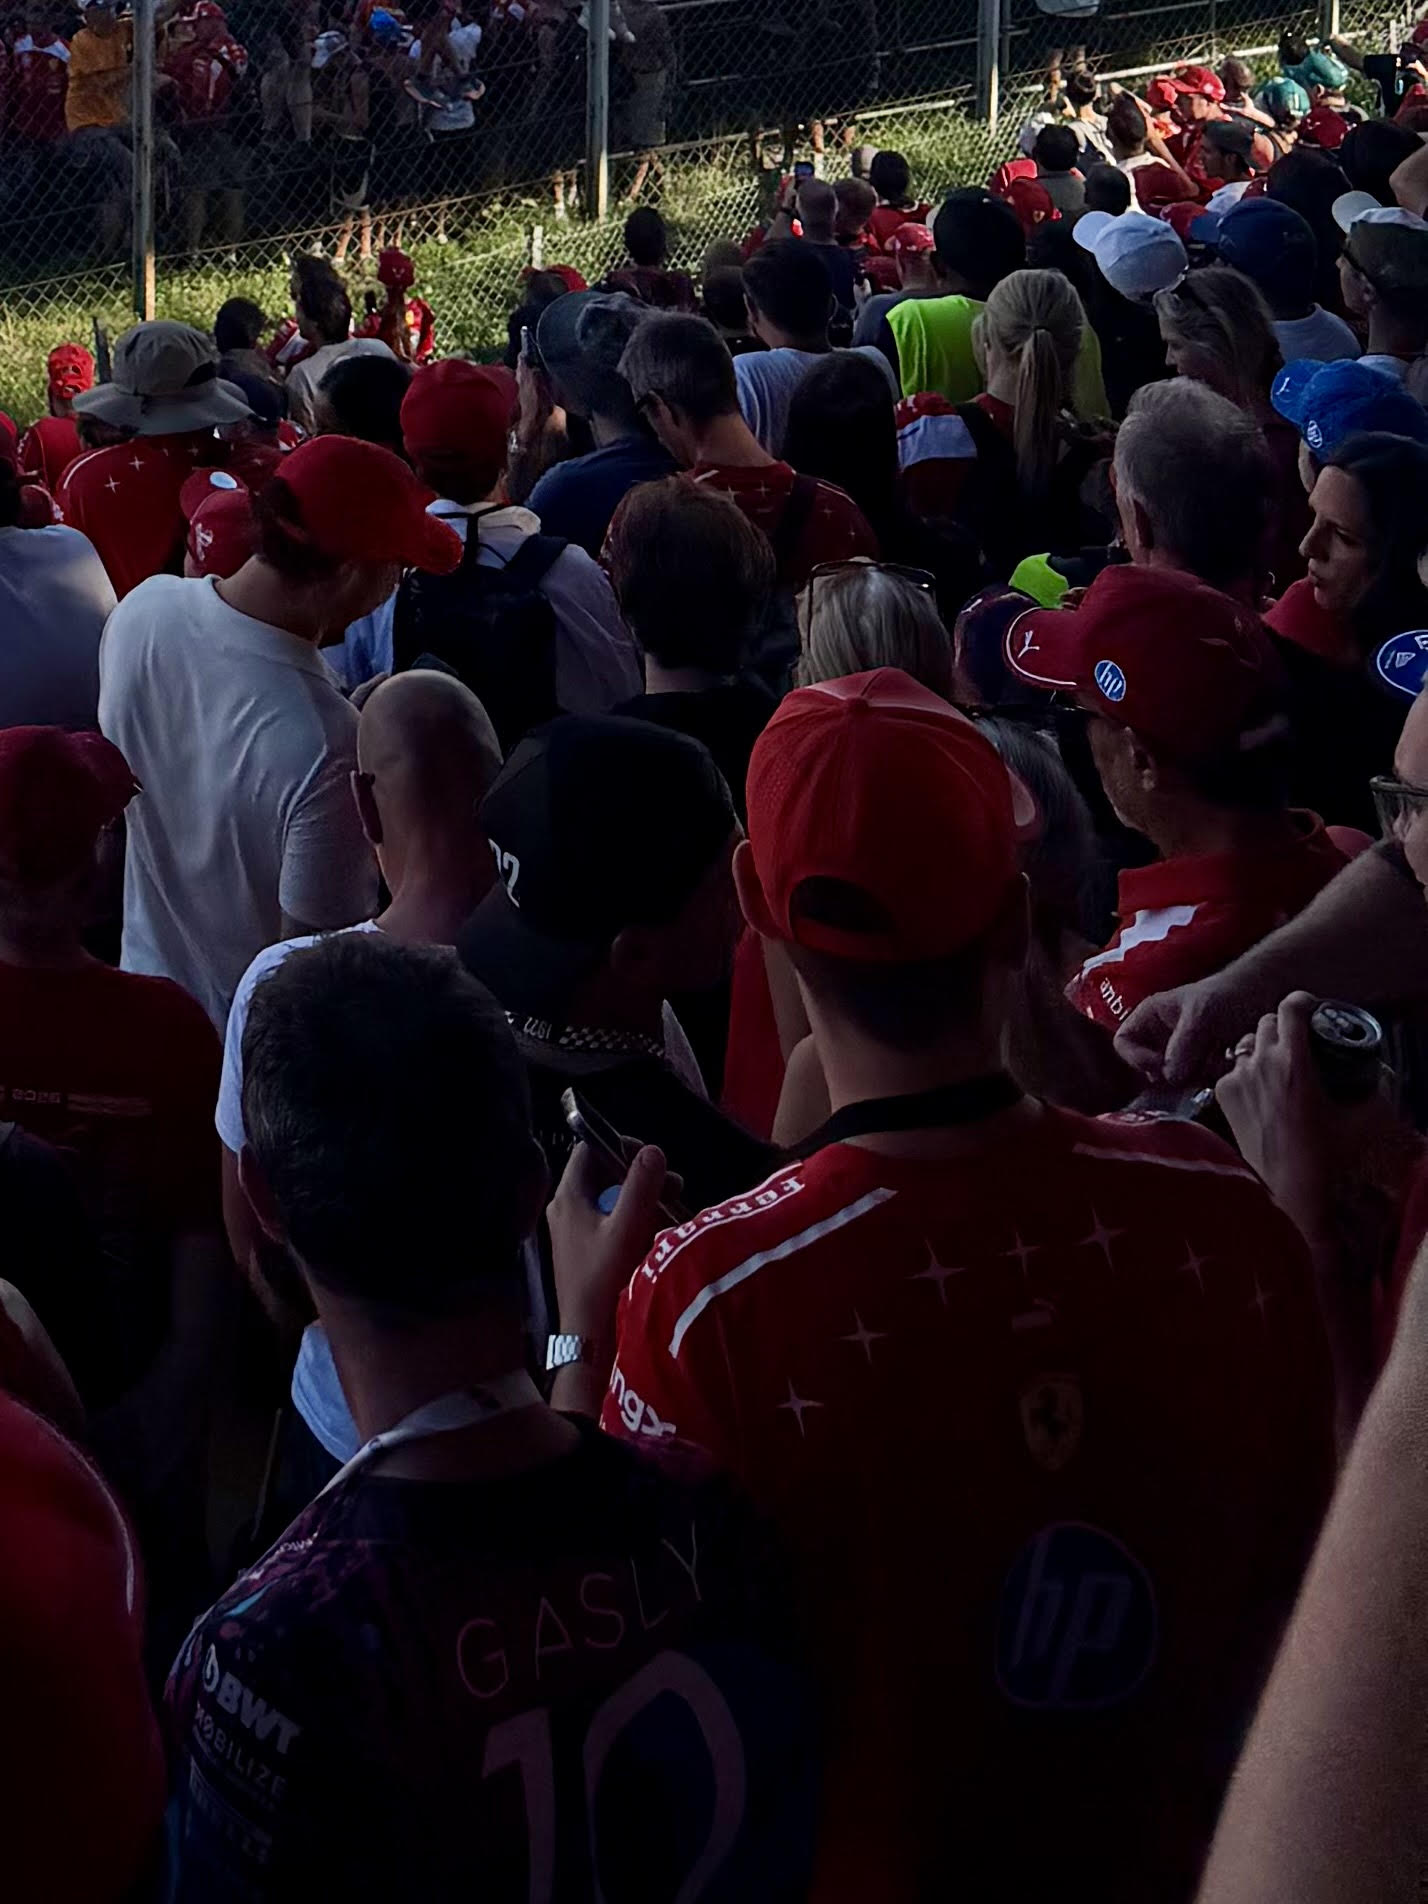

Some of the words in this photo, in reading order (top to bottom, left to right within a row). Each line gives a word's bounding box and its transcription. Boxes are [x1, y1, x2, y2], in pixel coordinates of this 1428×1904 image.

[1096, 662, 1124, 700] hp
[641, 1175, 807, 1285] Ferrari
[455, 1519, 703, 1702] GASLY
[1007, 1527, 1134, 1705] hp
[216, 1671, 305, 1756] BWT
[481, 1648, 748, 1904] 10
